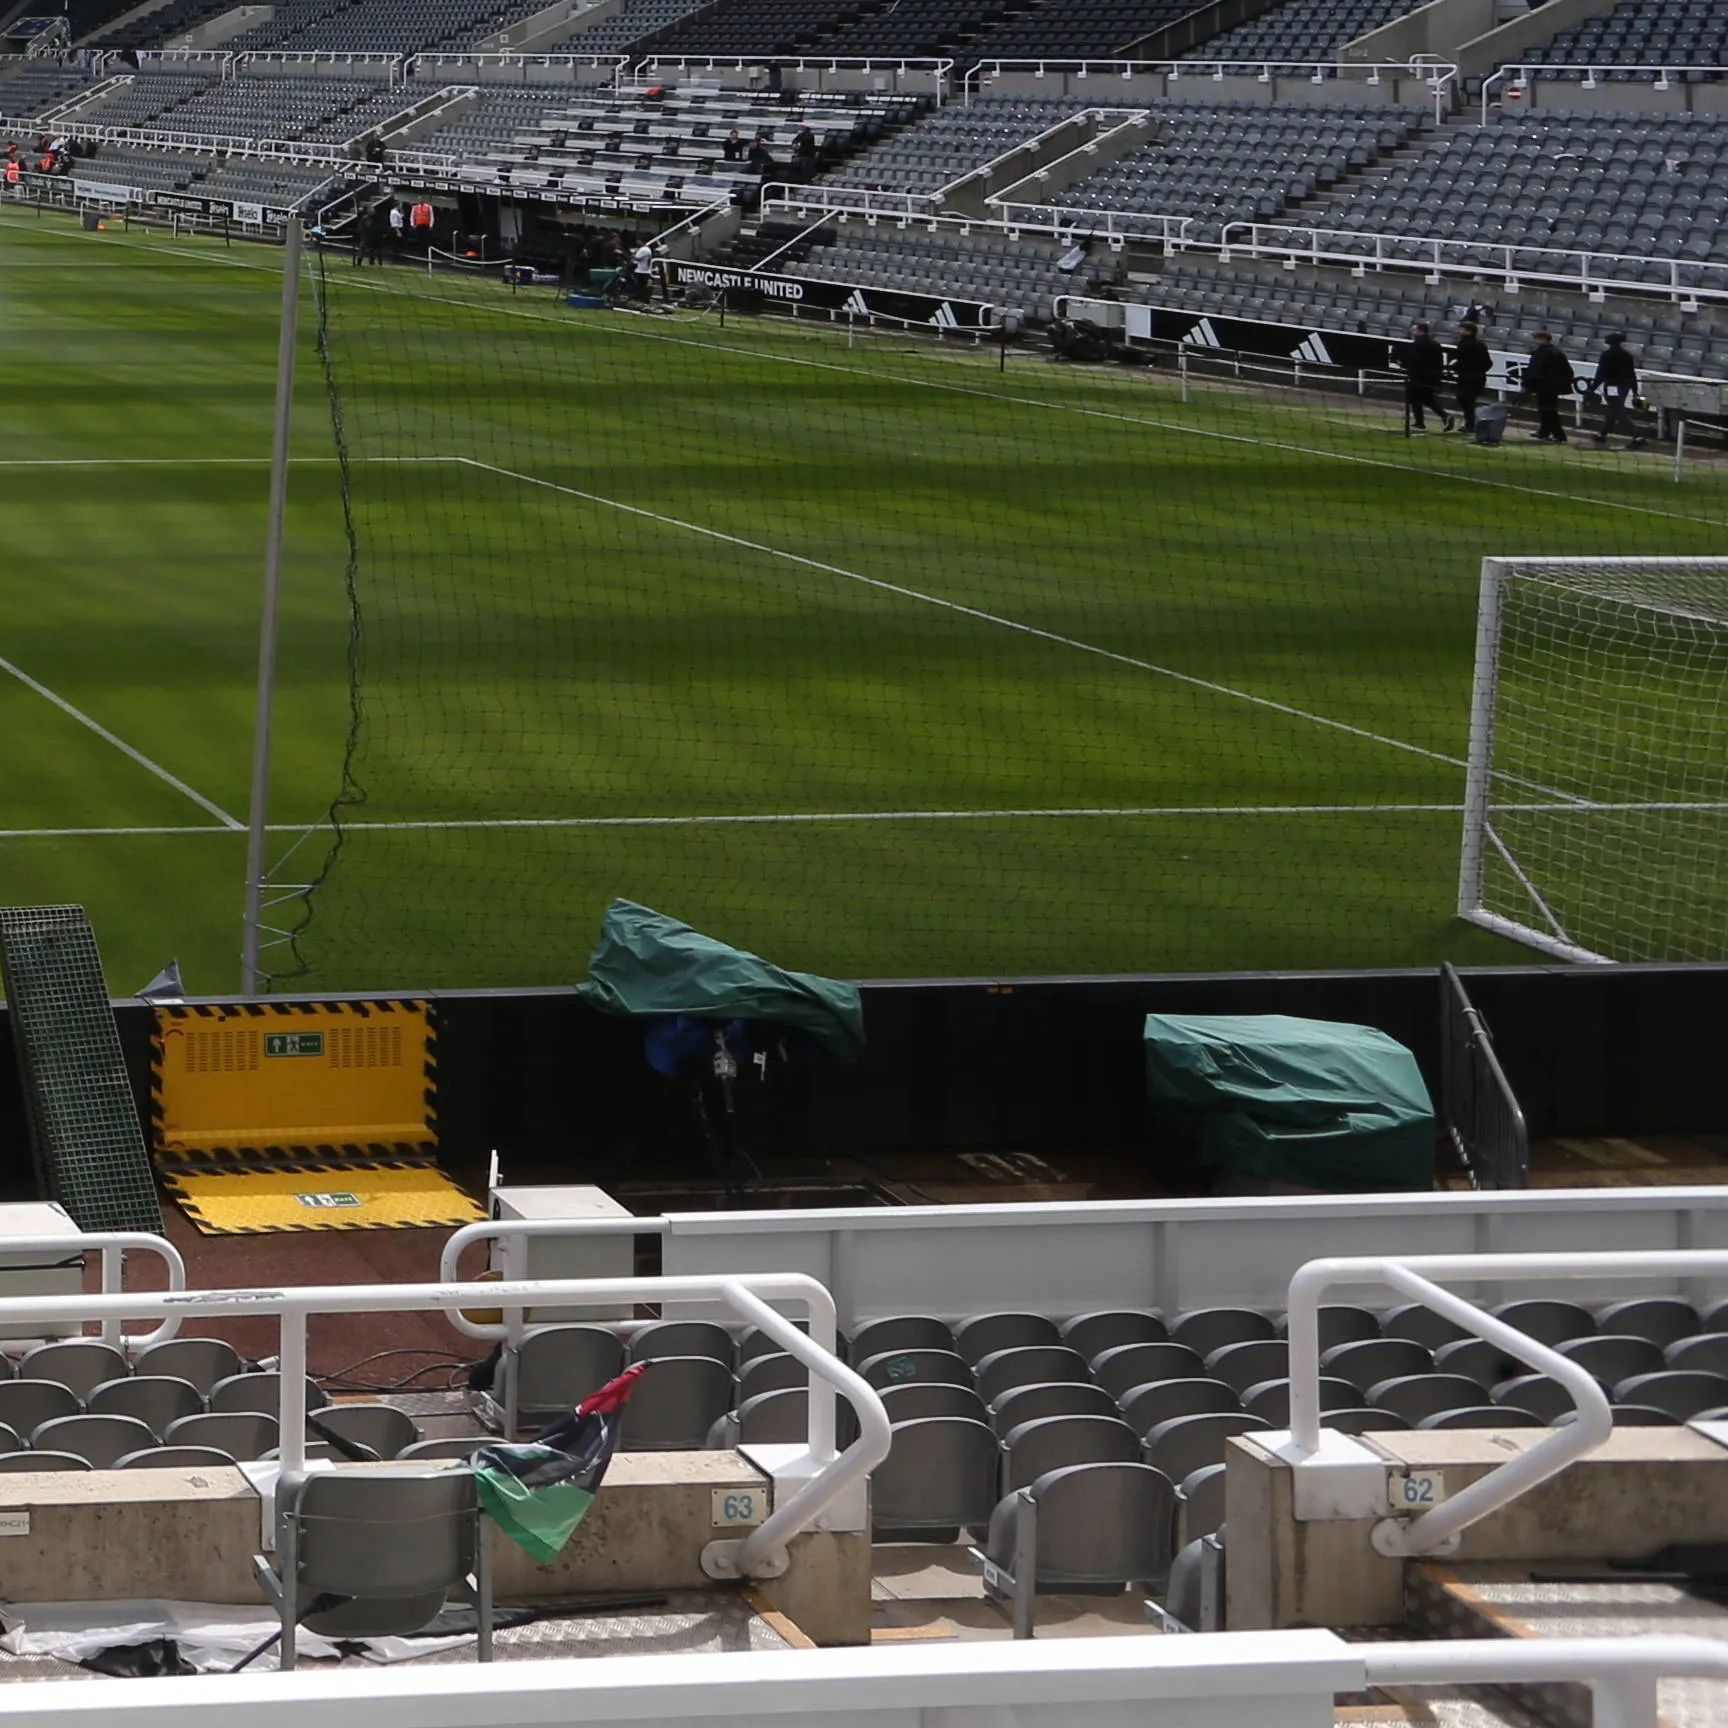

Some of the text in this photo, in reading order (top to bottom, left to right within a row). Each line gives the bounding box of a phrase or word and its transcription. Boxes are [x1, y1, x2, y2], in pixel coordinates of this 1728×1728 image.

[754, 278, 804, 299] UNITED
[1404, 1477, 1433, 1502] 62
[724, 1495, 752, 1519] 63
